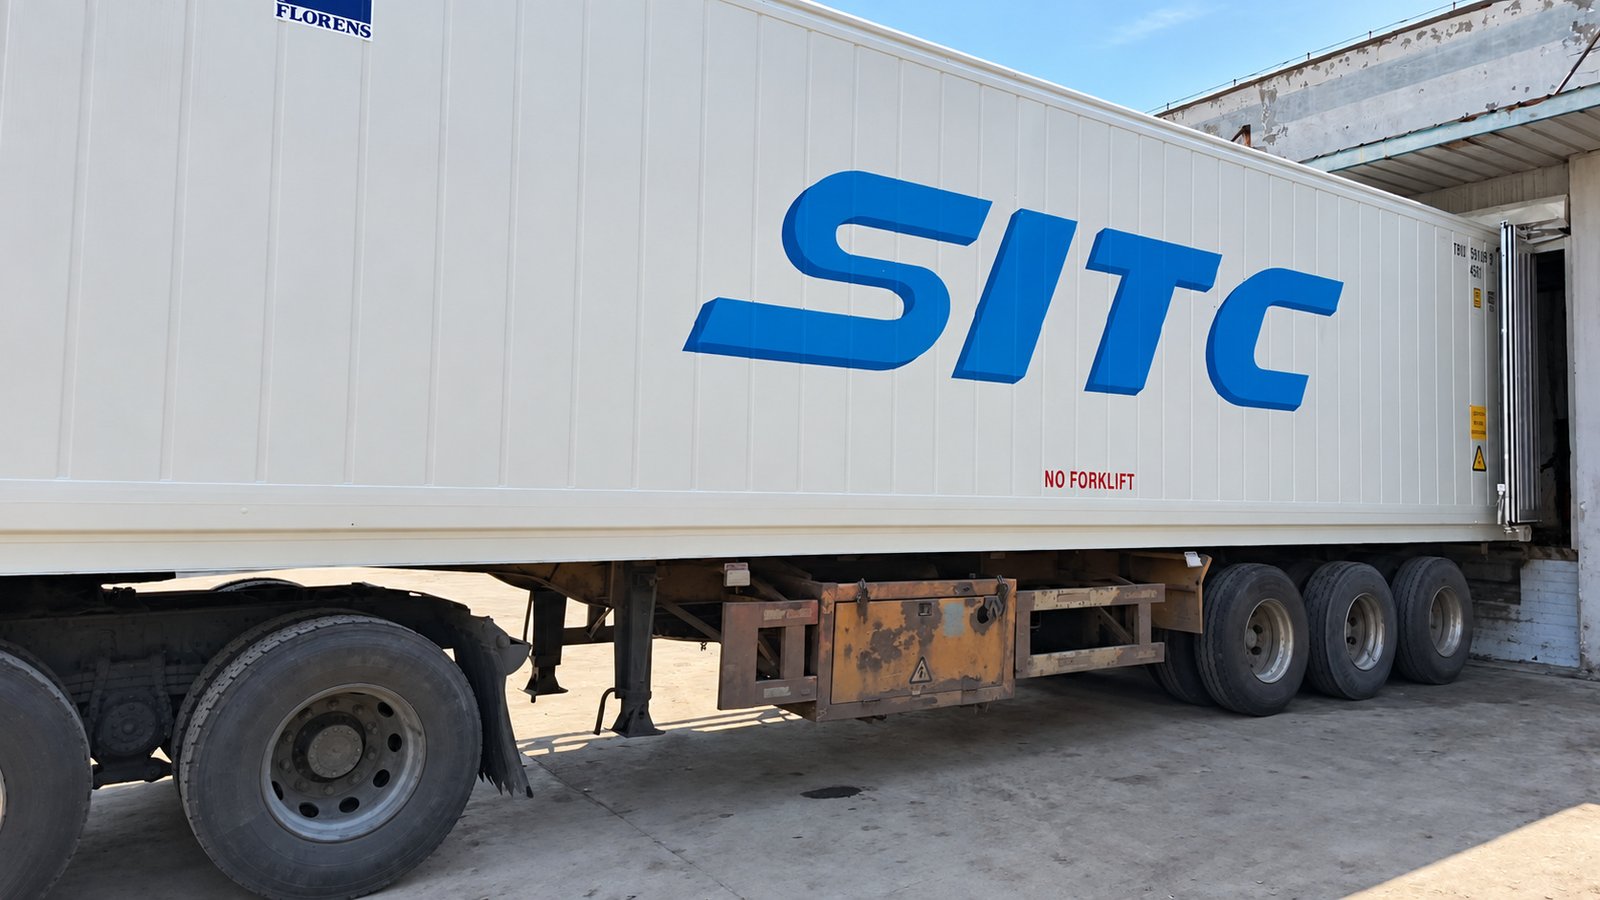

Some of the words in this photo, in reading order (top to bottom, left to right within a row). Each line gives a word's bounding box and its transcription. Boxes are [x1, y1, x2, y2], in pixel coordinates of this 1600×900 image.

[276, 3, 371, 38] FLORENS
[682, 170, 1344, 412] SITC
[1045, 469, 1065, 488] NO
[1070, 470, 1135, 491] FORKLIFT
